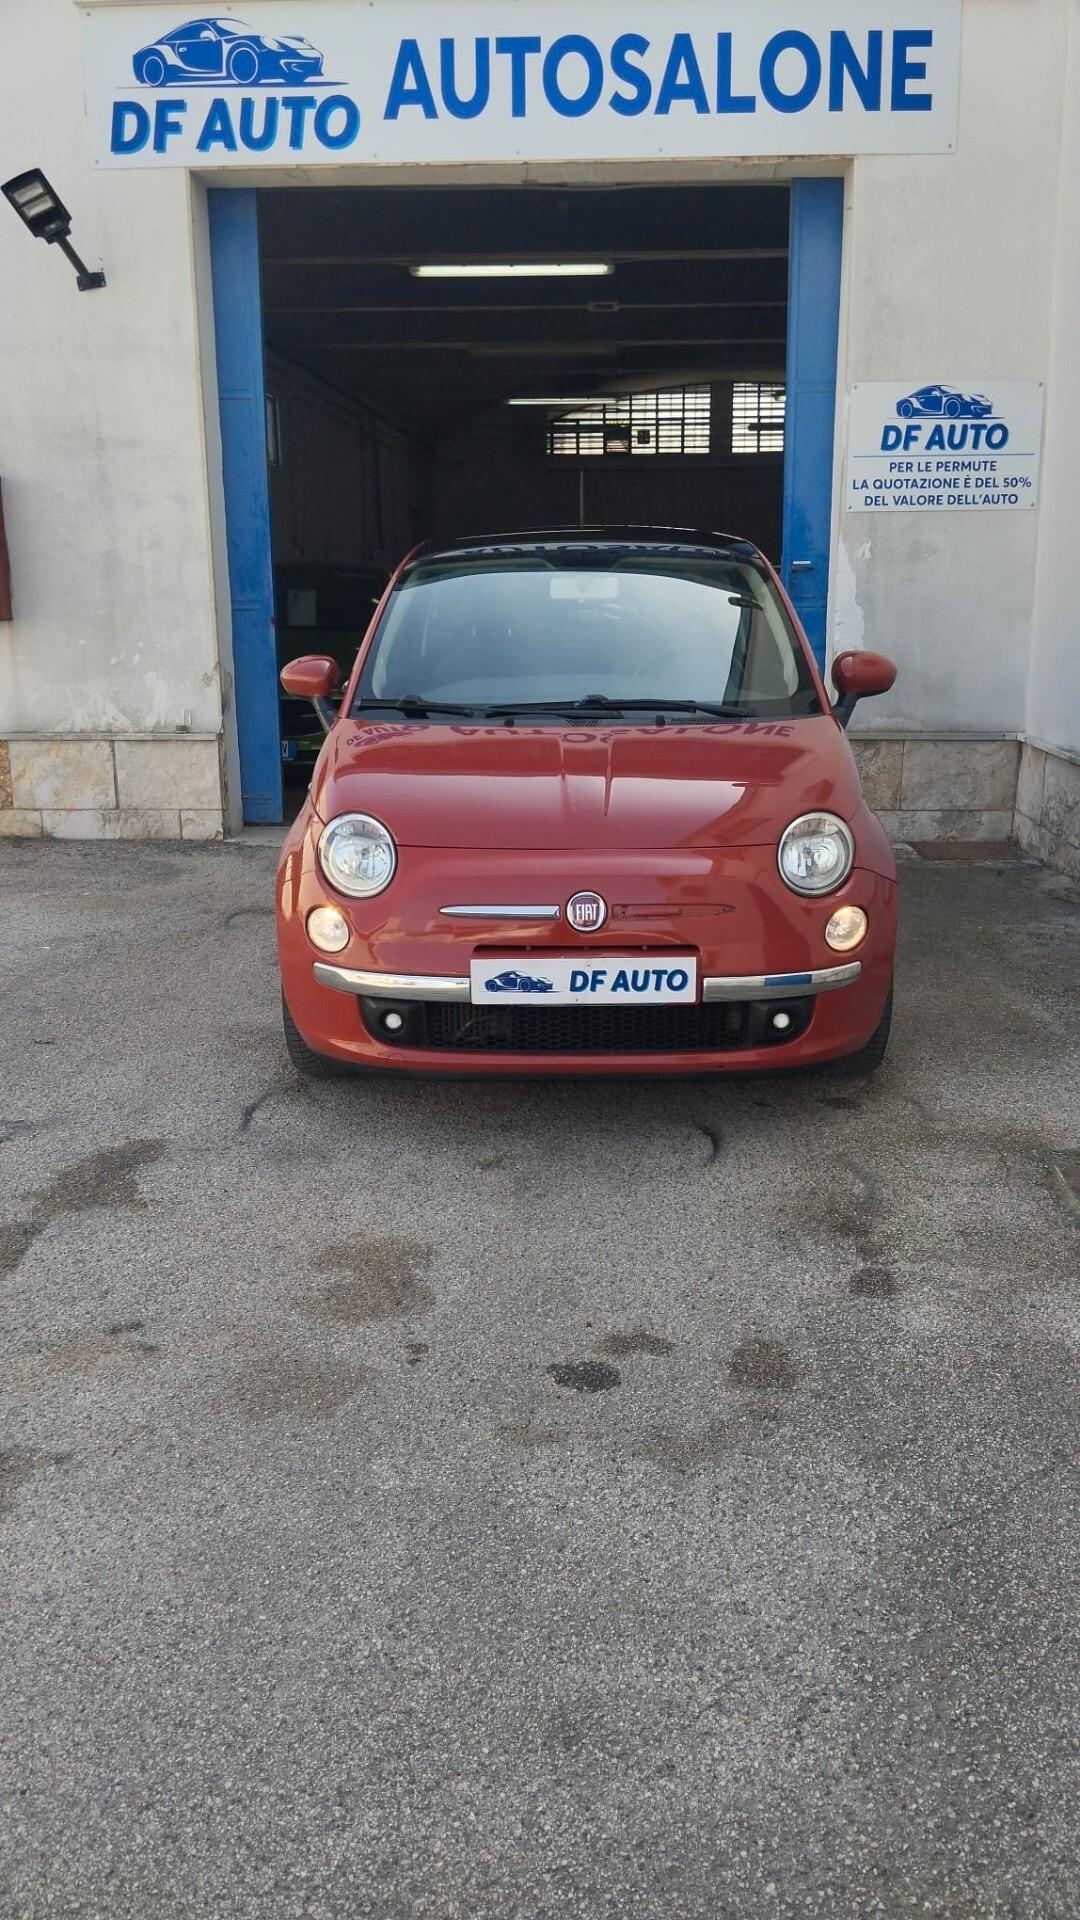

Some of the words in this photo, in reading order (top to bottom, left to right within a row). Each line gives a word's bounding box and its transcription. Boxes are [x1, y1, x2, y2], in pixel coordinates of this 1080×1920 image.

[384, 30, 933, 120] AUTOSALONE
[111, 99, 187, 155] DF
[196, 95, 361, 152] AUTO
[880, 424, 922, 452] DF
[924, 423, 1009, 451] AUTO
[889, 461, 913, 473] PER
[917, 461, 932, 472] LE
[936, 460, 998, 472] PERMUTE
[852, 479, 869, 490] LA
[872, 478, 960, 490] QUOTAZIONE
[975, 477, 1000, 489] DEL
[1003, 477, 1032, 488] 50%
[864, 495, 889, 506] DEL
[893, 495, 943, 506] VALORE
[946, 493, 1019, 505] DELL'AUTO
[576, 903, 598, 921] FIAT
[569, 970, 607, 992] DF
[610, 969, 689, 992] AUTO
